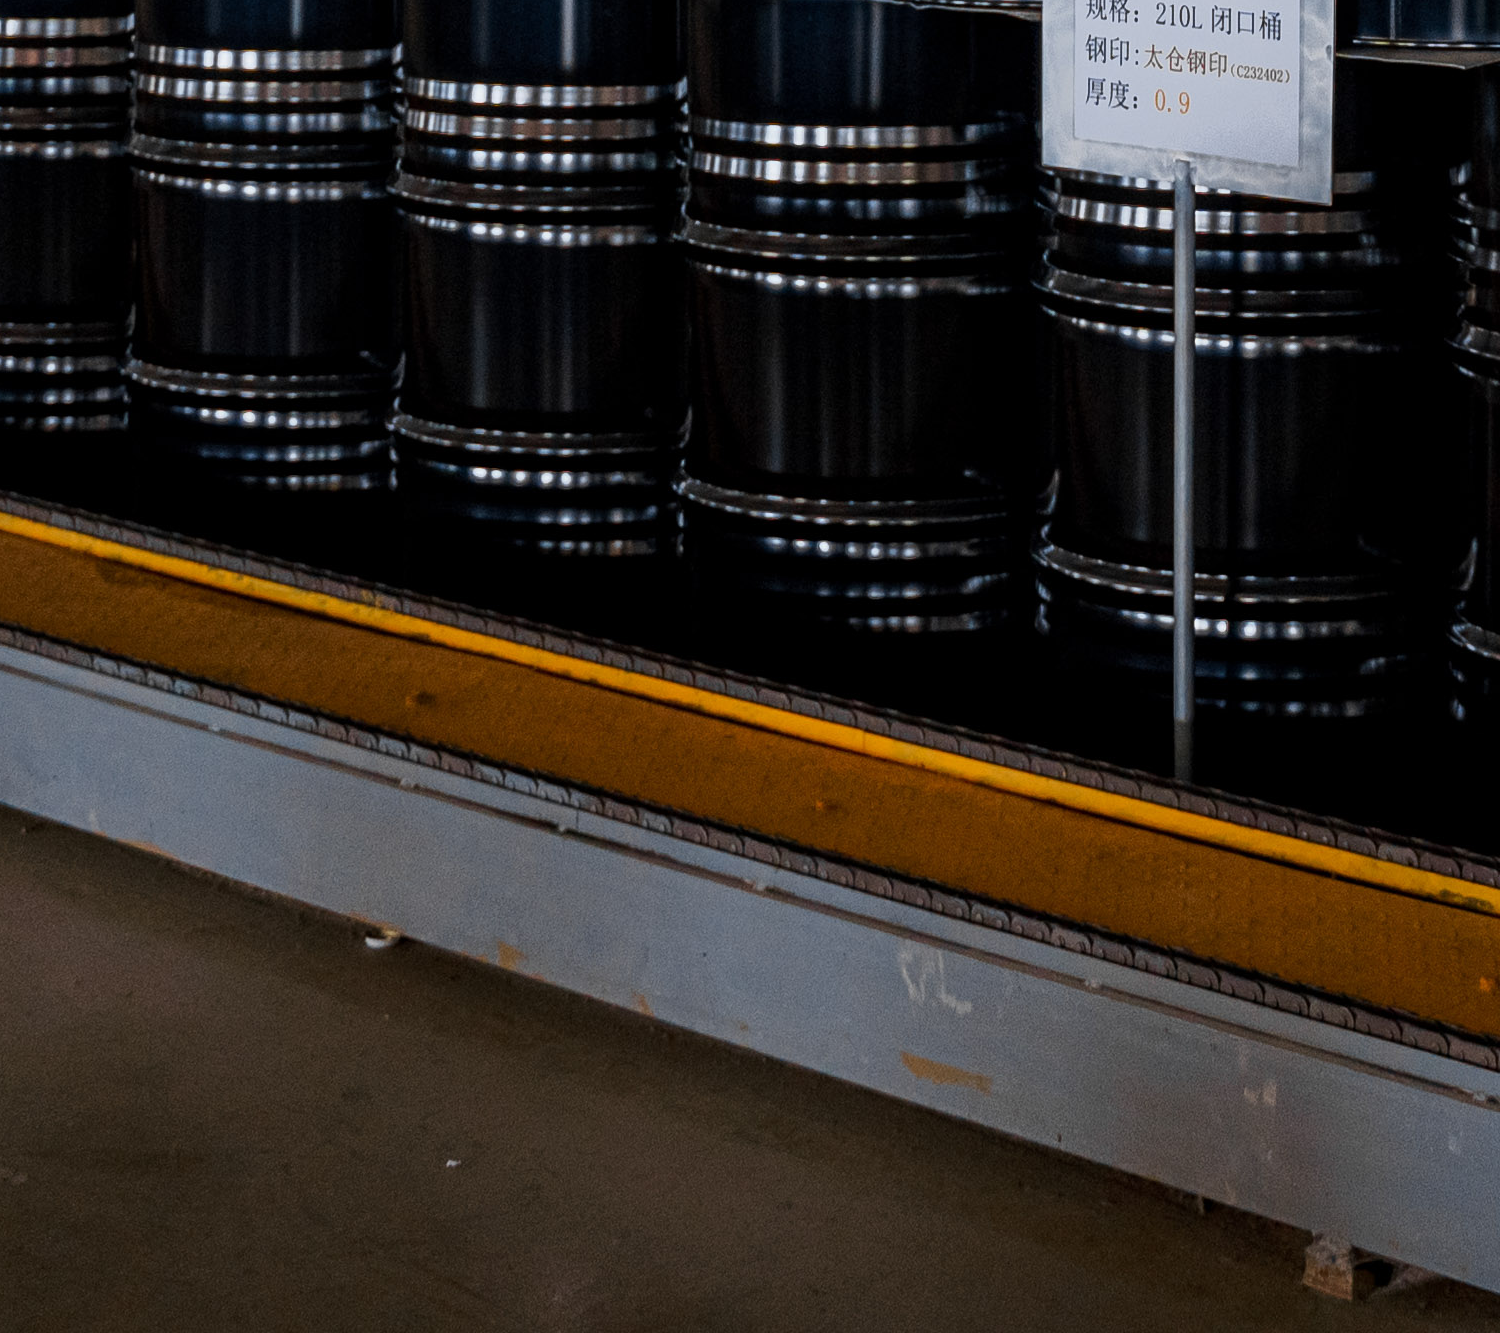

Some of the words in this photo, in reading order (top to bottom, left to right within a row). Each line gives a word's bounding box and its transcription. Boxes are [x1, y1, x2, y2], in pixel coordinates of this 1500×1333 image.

[1155, 2, 1203, 30] 210L
[1211, 5, 1282, 41] 闭口桶
[1085, 77, 1138, 111] 厚度：
[1154, 88, 1190, 115] 0.9
